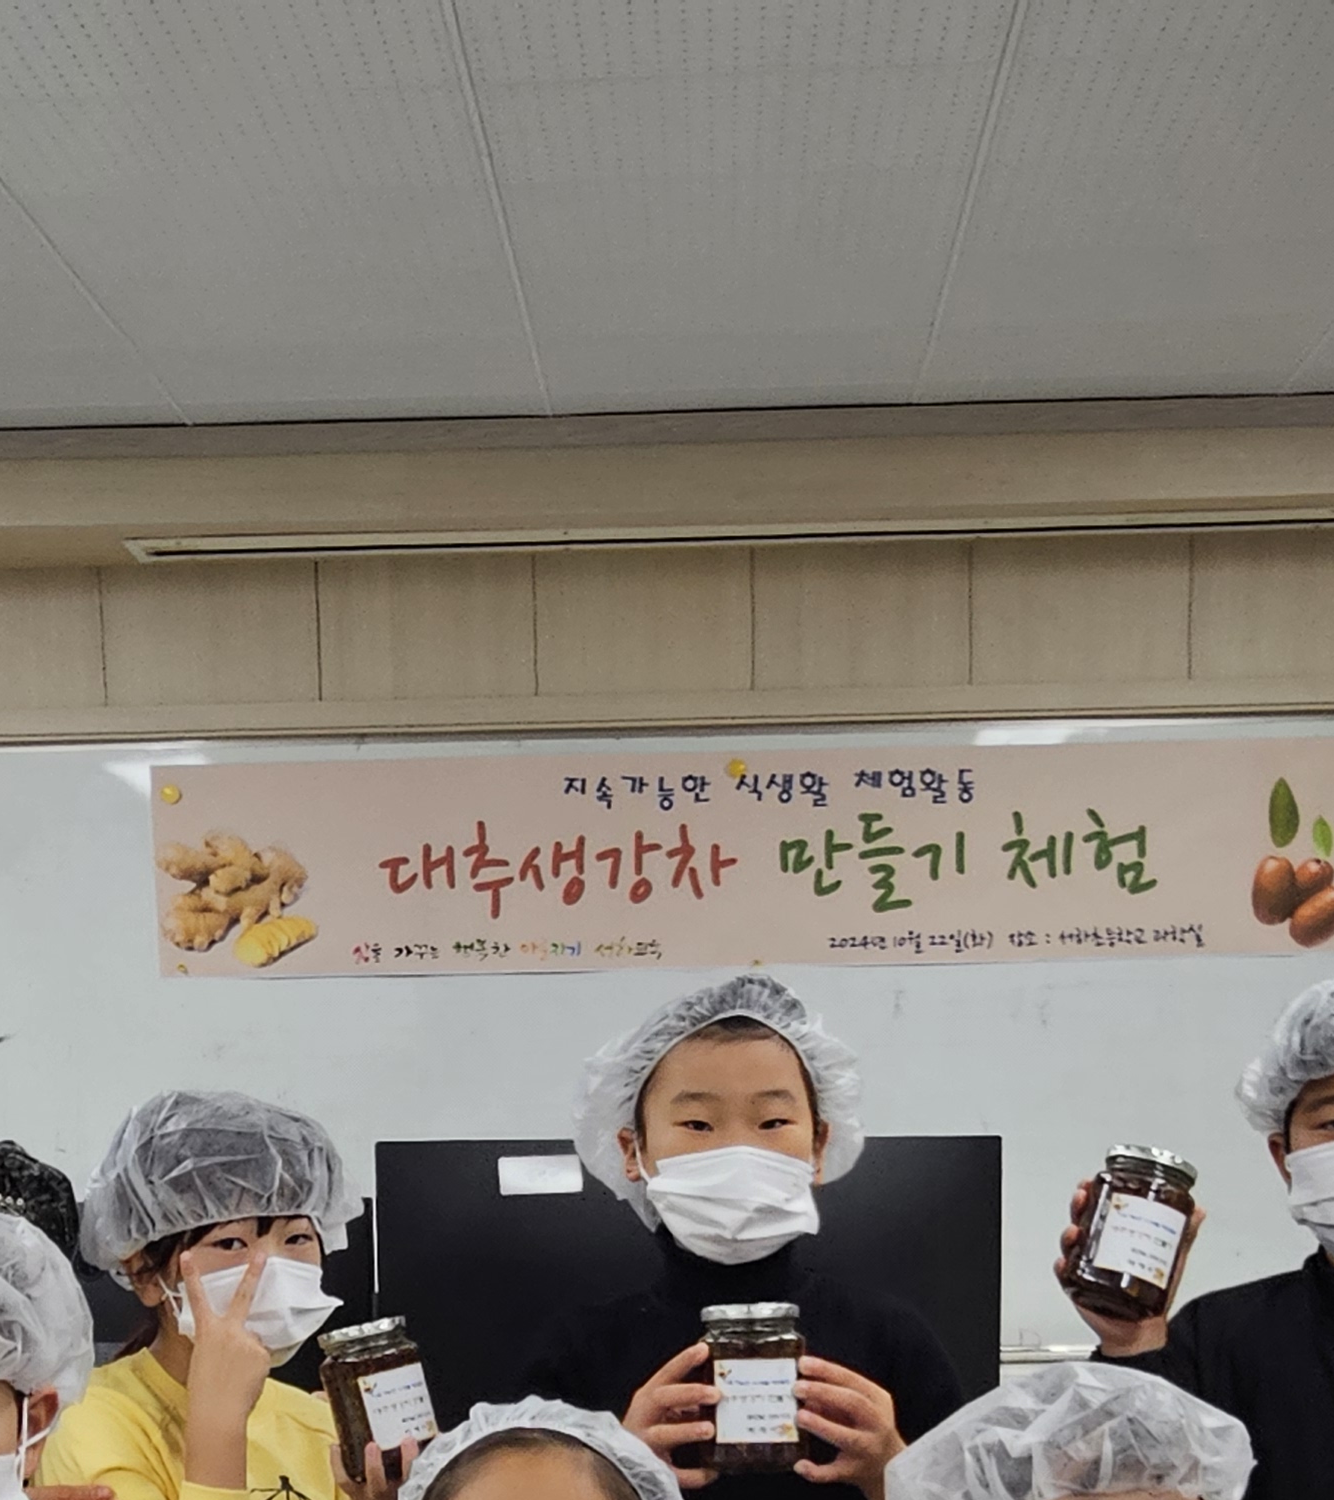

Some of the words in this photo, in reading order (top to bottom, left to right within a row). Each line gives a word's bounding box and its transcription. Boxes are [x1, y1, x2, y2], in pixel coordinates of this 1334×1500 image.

[563, 774, 712, 811] 지속가능한
[735, 770, 829, 808] 식생활
[854, 767, 976, 804] 체험활동
[378, 820, 739, 920] 대추생강차
[779, 811, 966, 913] 만들기
[1001, 808, 1159, 895] 체험
[828, 935, 887, 950] 2024년
[893, 930, 924, 954] 10월
[928, 928, 994, 953] 22일(화)
